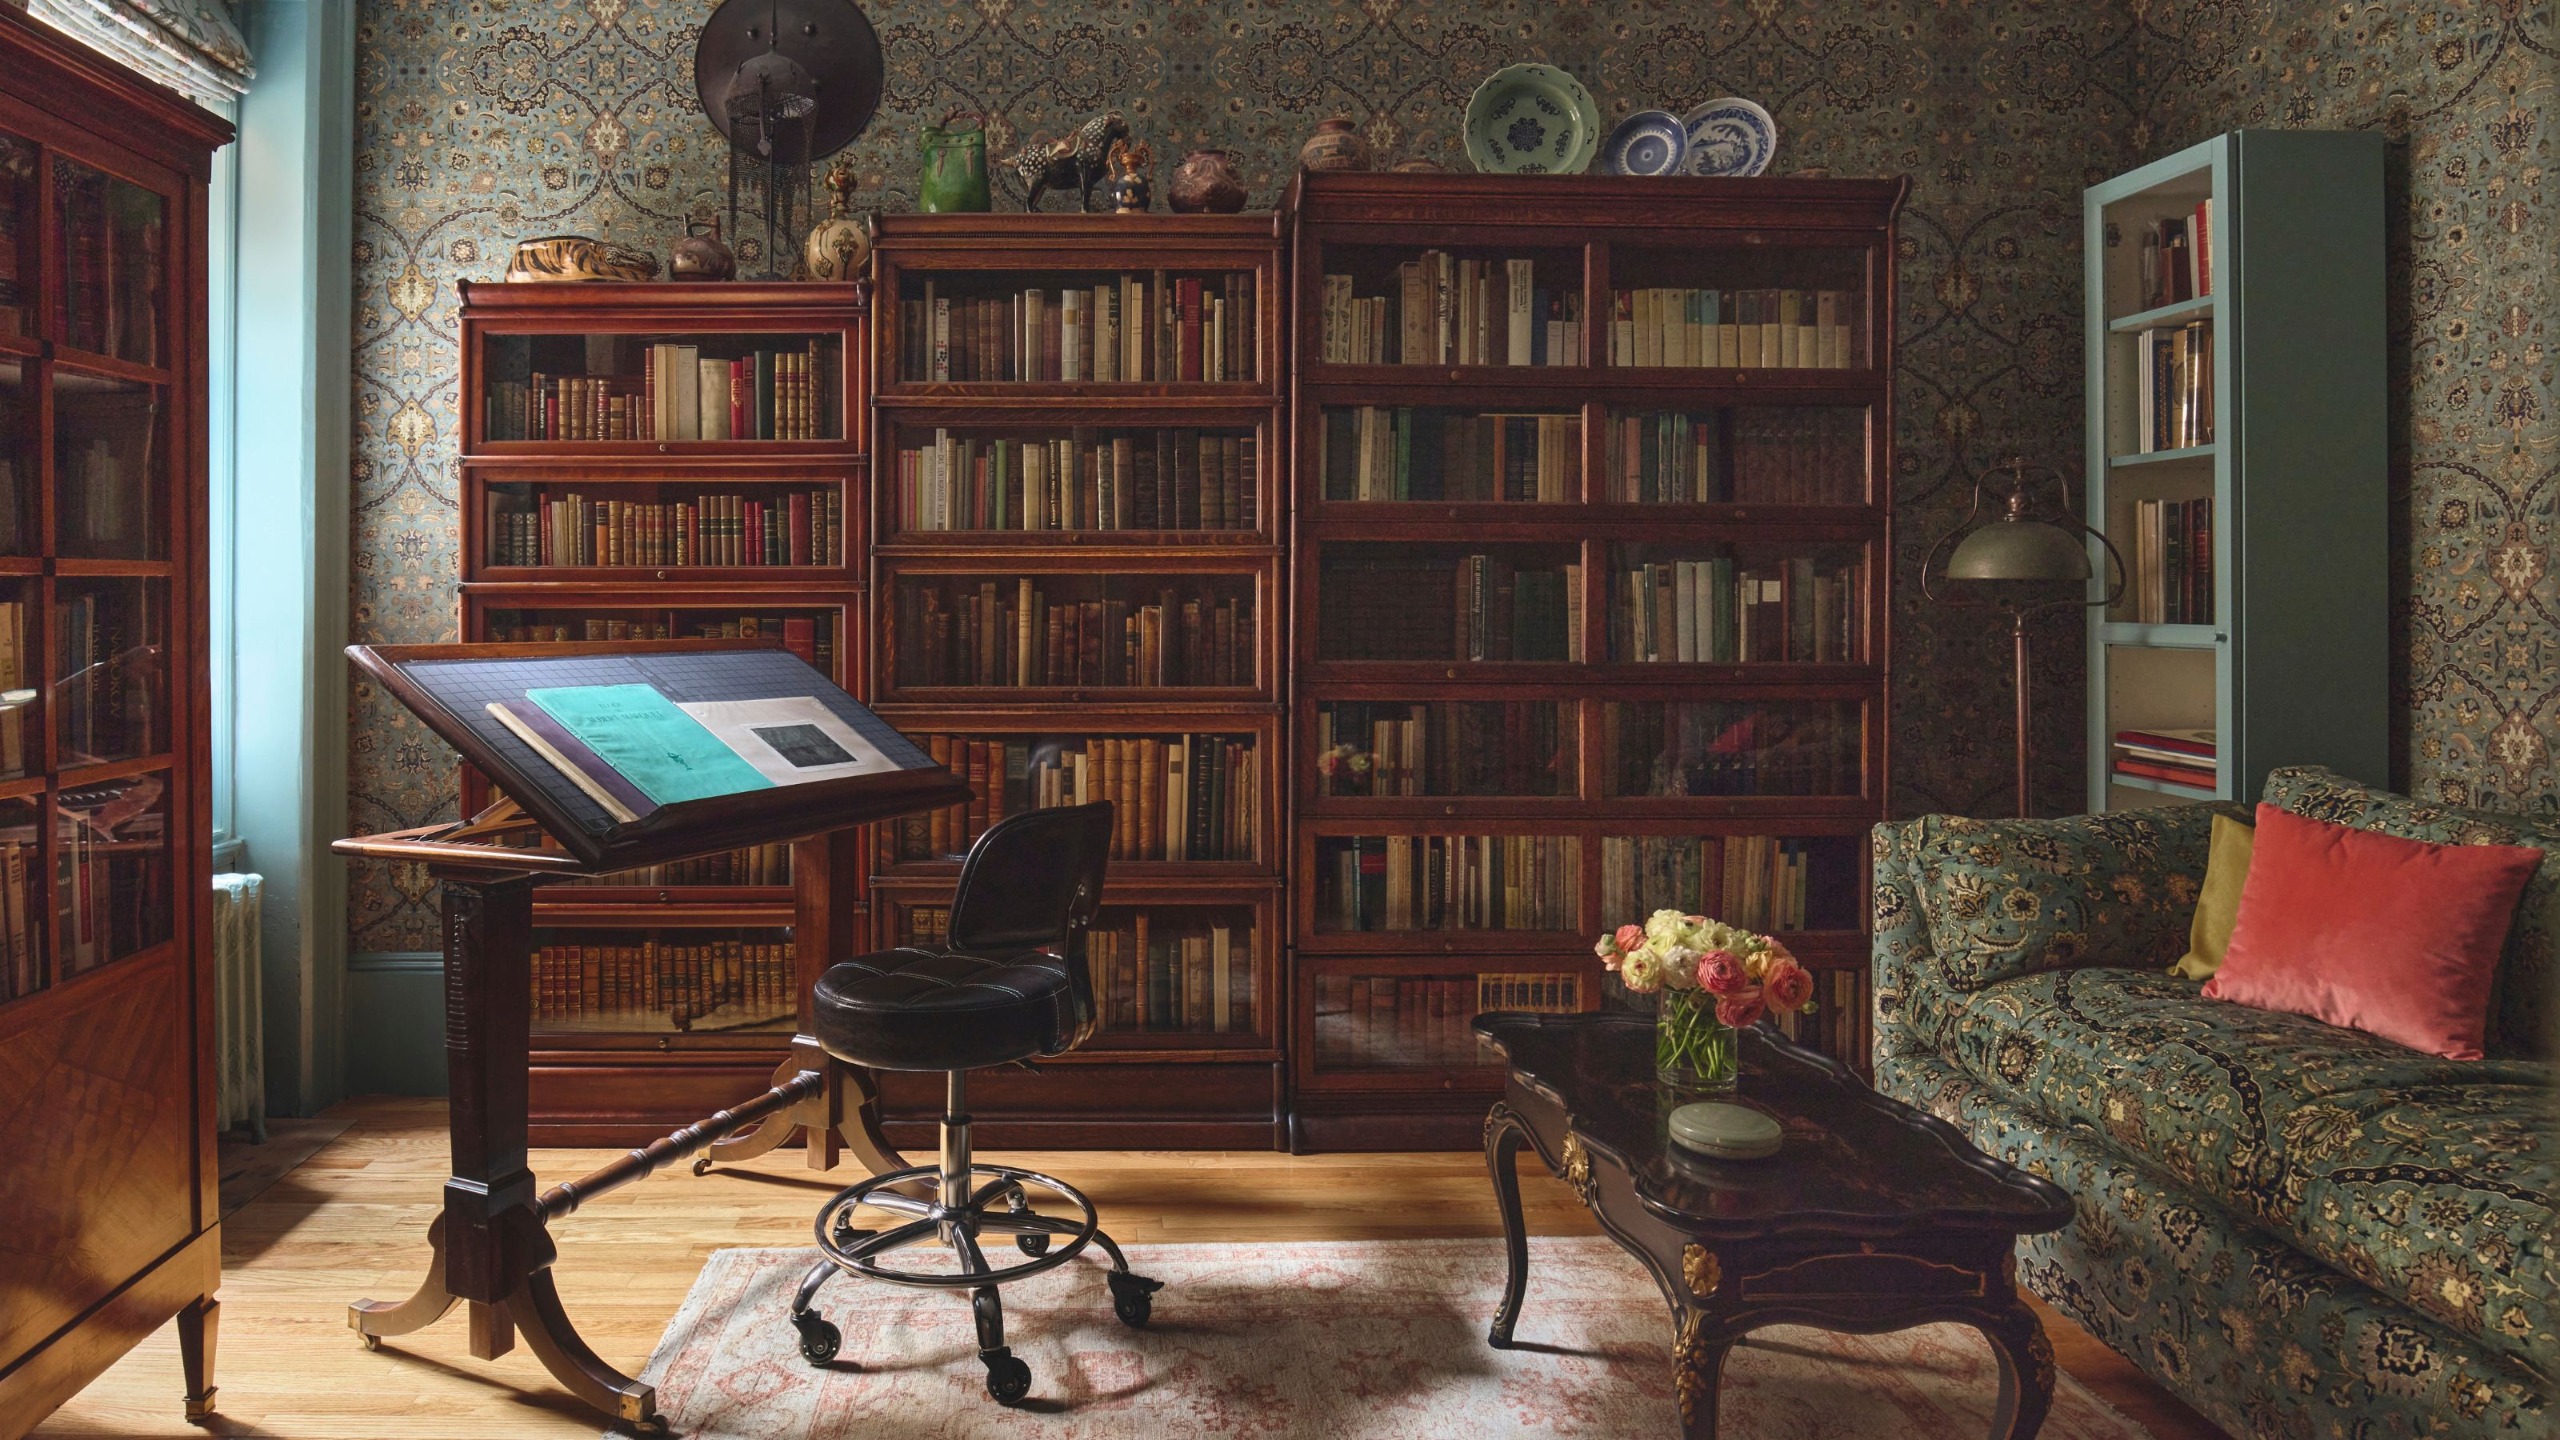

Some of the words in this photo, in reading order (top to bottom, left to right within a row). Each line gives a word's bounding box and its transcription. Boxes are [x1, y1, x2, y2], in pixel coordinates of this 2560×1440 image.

[937, 454, 945, 464] DAS
[937, 467, 945, 502] LENINGRADER
[109, 626, 122, 719] NABOKOV
